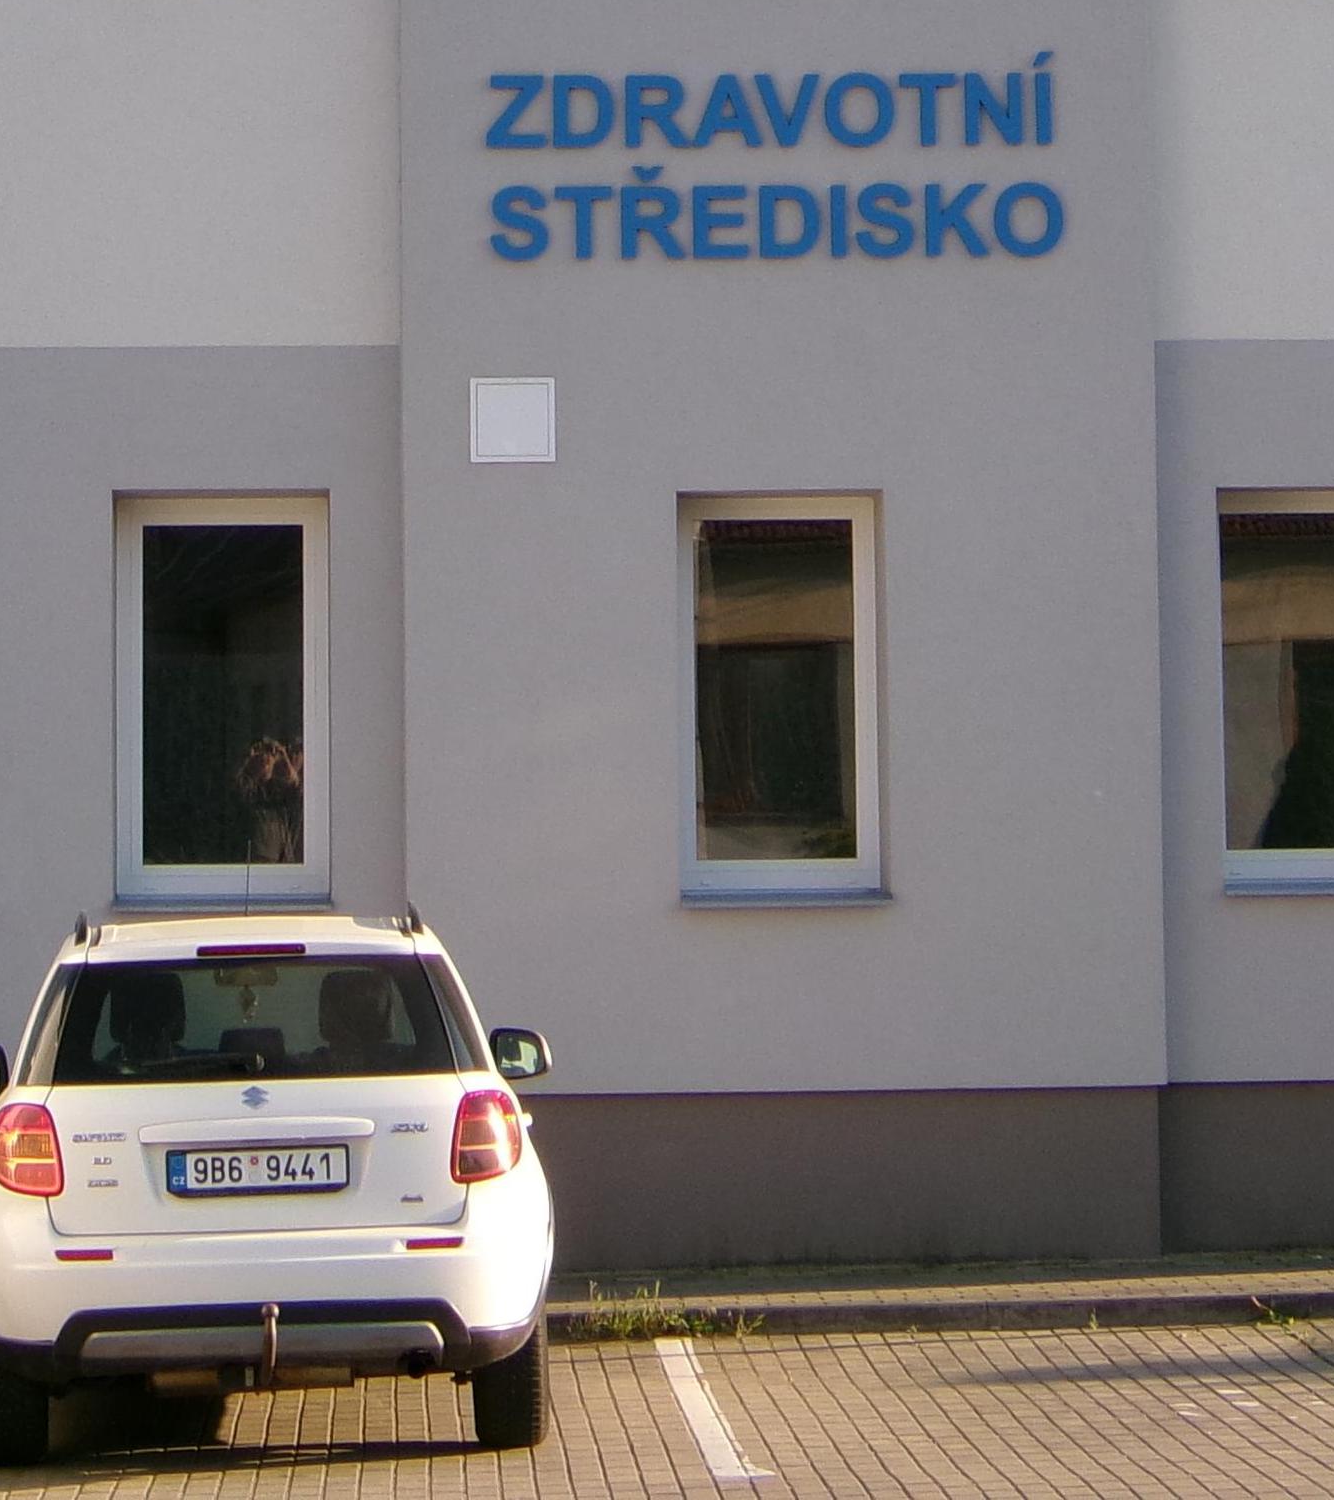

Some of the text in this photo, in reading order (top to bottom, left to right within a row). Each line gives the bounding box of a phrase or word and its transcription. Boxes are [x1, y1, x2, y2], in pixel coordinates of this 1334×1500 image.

[486, 51, 1054, 150] ZDRAVOTNÍ
[490, 165, 1064, 261] STŘEDISKO
[172, 1153, 331, 1186] CZ 9B6 9441
